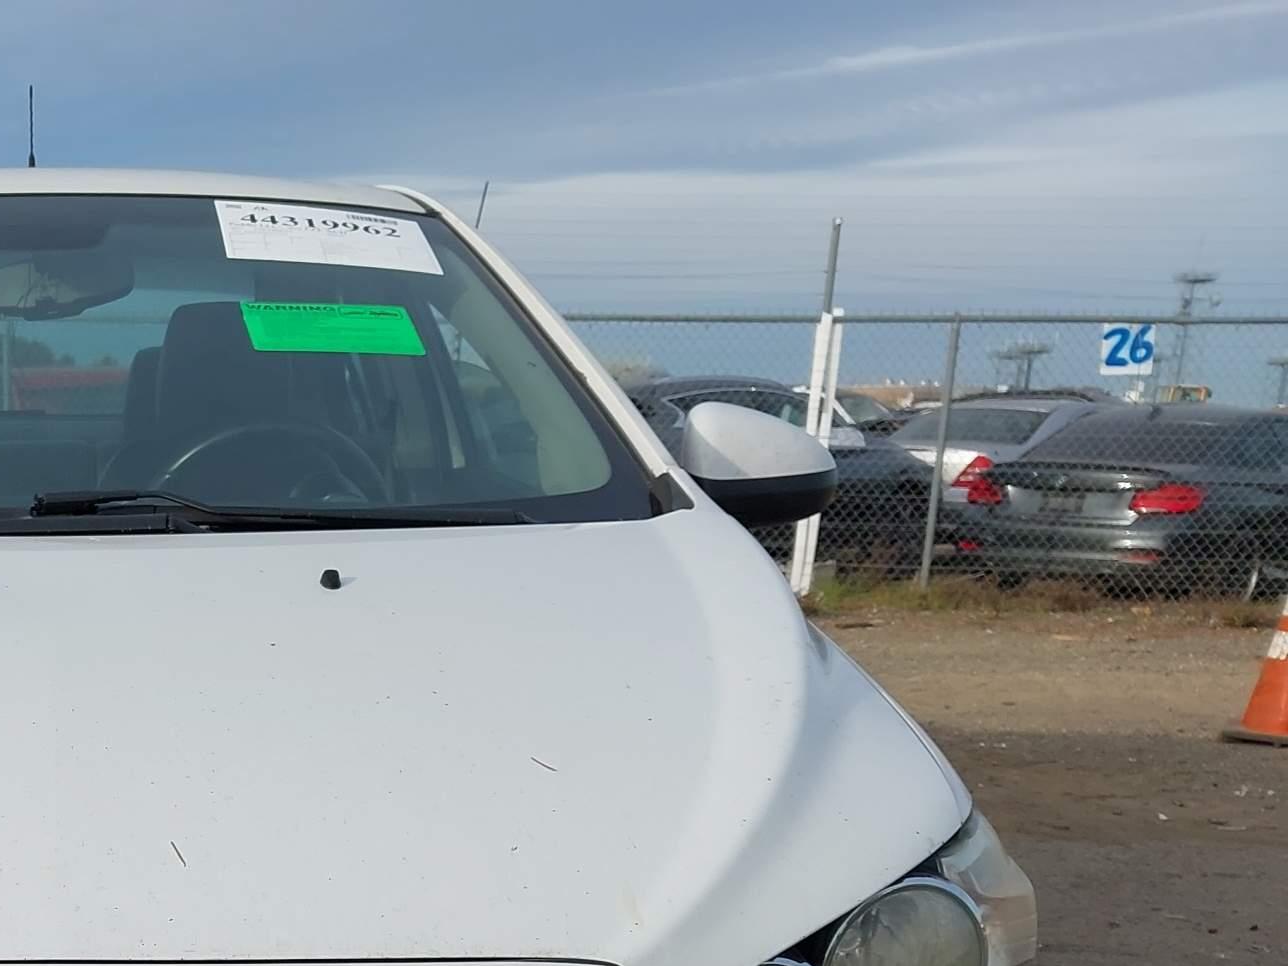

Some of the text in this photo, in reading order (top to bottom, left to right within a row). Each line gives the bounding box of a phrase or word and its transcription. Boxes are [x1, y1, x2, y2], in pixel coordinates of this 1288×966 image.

[240, 212, 401, 238] 44319962
[245, 303, 337, 313] WARNING
[1103, 324, 1154, 366] 26
